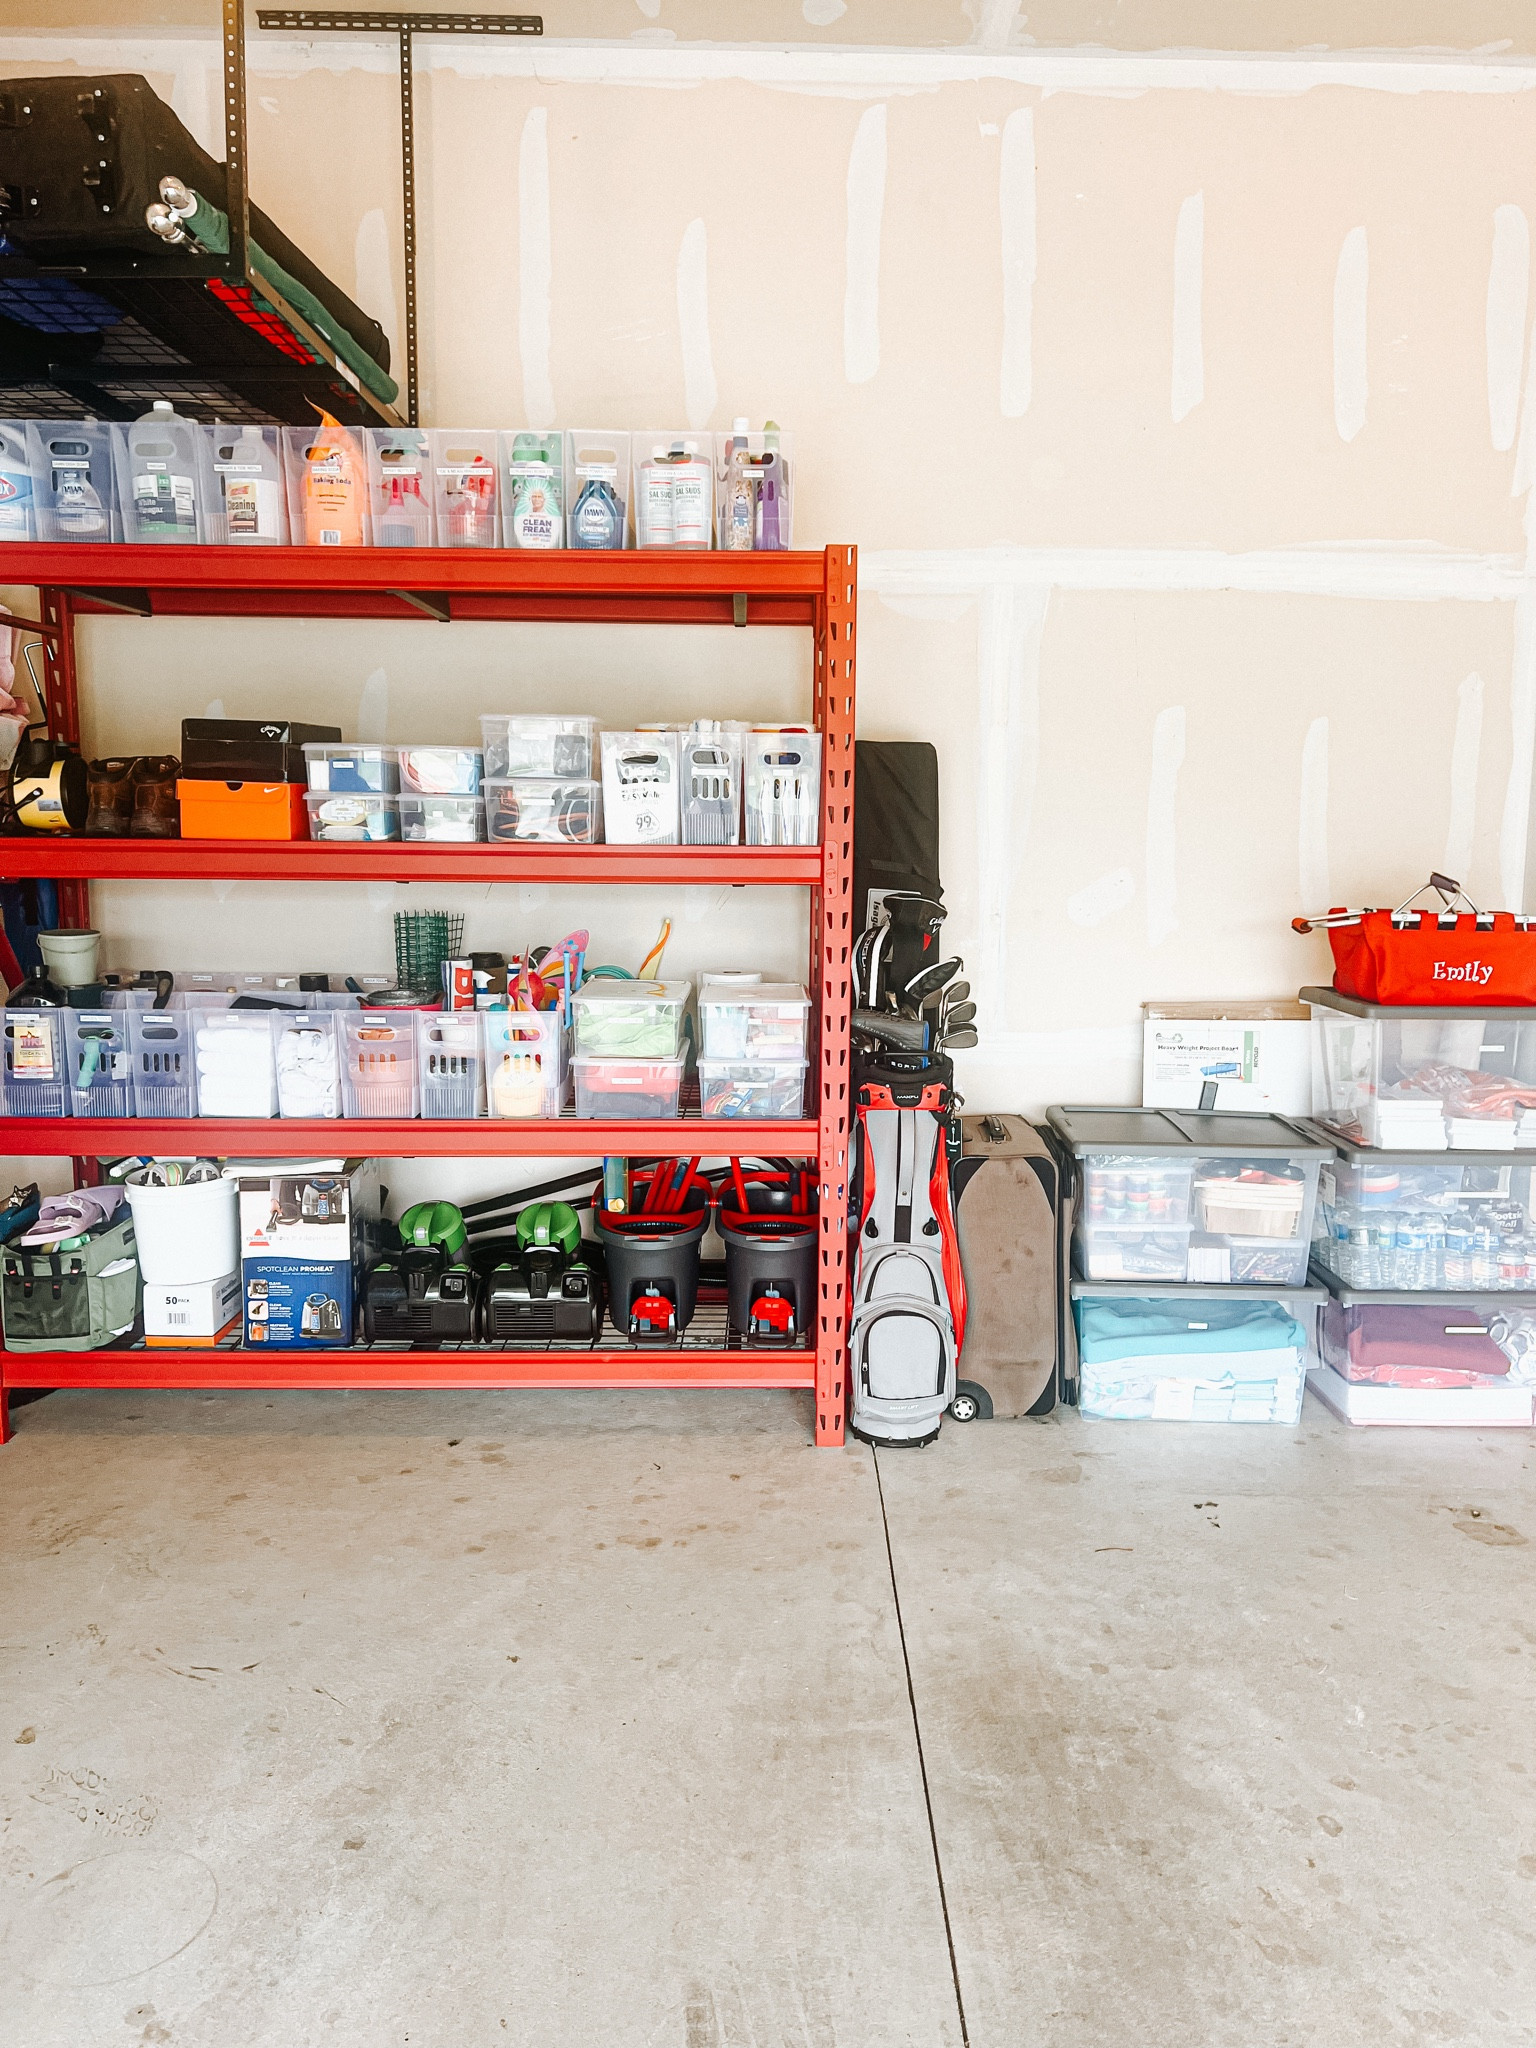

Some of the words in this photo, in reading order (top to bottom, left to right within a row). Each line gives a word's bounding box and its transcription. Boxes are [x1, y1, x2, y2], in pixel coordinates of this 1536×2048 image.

[649, 490, 659, 498] SAL
[660, 490, 672, 499] SUD
[523, 519, 552, 527] CLEAN
[523, 526, 552, 534] FREAK
[871, 901, 881, 926] Isag
[1432, 961, 1493, 985] Emily
[165, 1296, 178, 1305] 50
